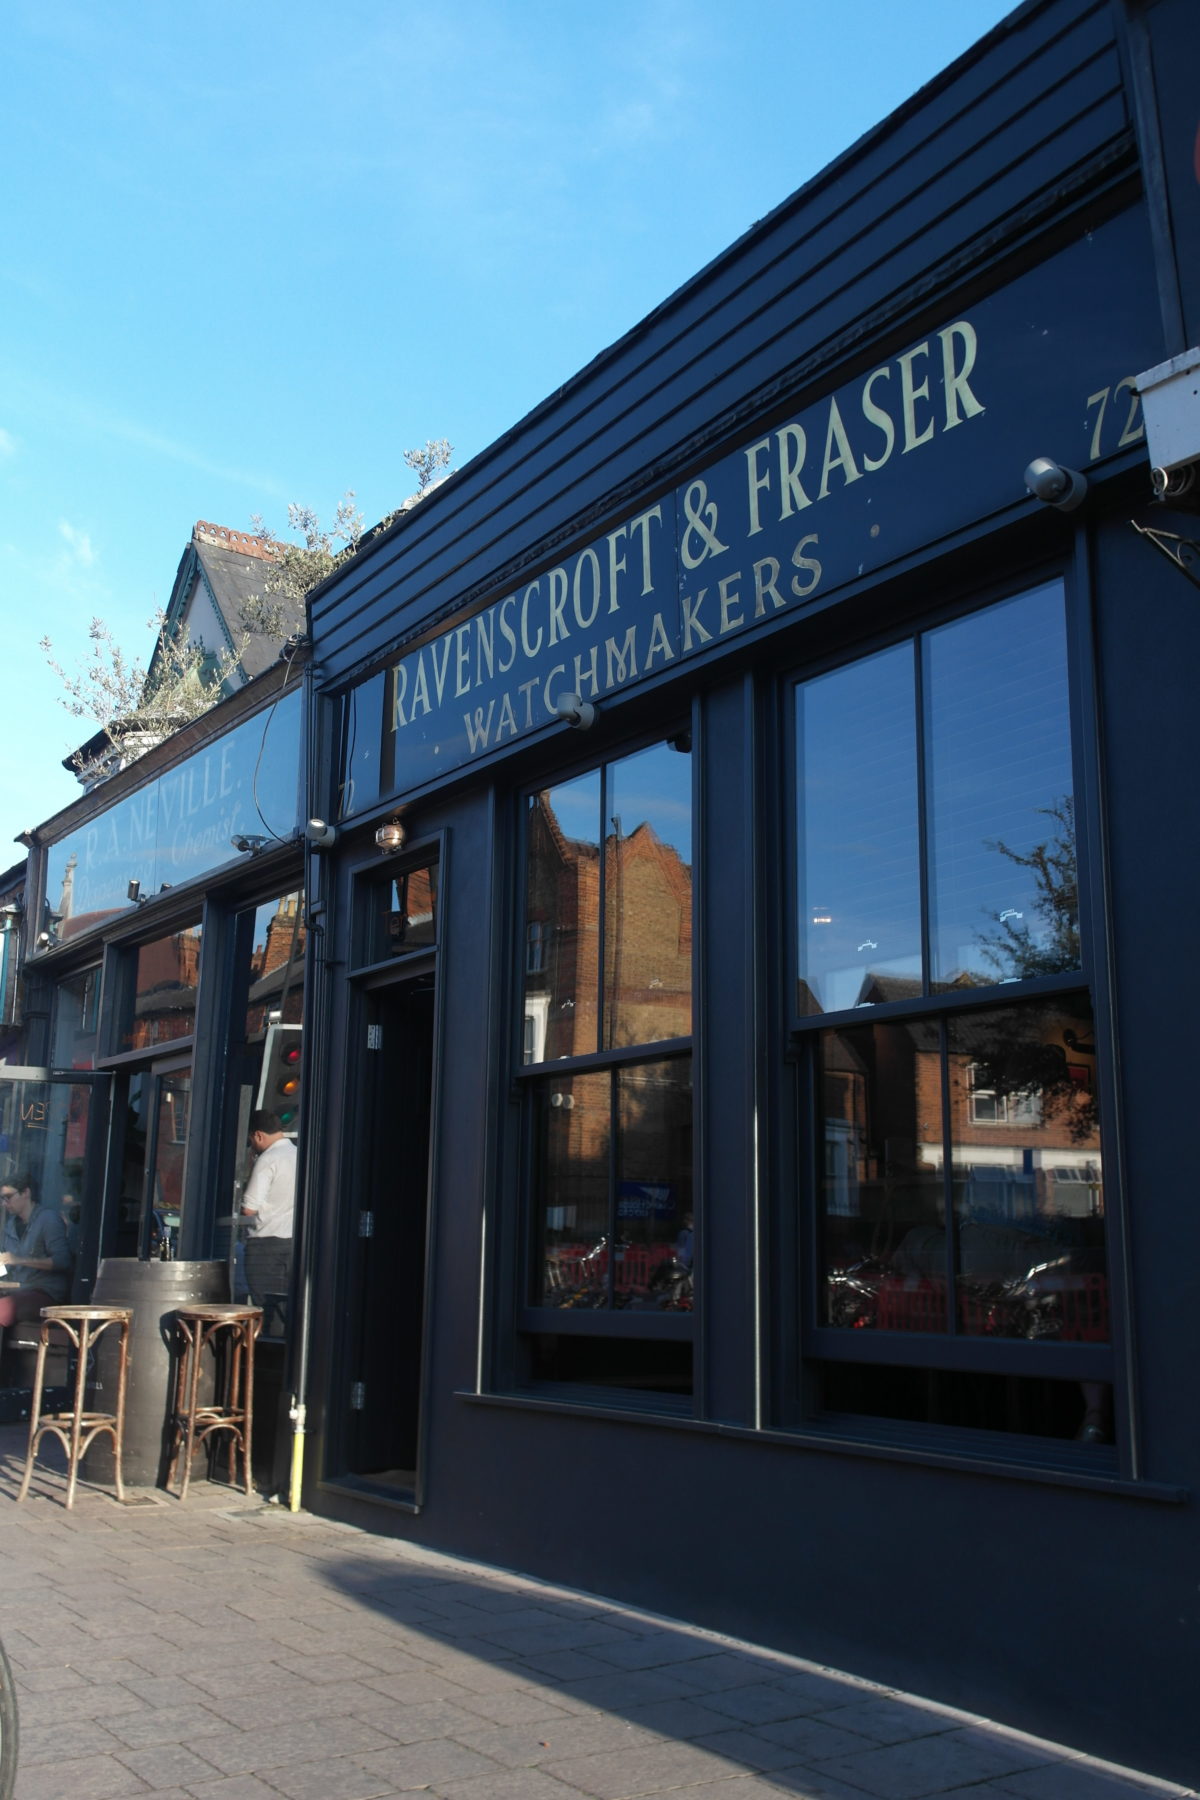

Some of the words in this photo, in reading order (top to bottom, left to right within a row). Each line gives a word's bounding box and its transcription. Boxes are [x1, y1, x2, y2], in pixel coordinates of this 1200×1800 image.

[391, 504, 663, 733] RAVENSCROFT
[681, 479, 730, 570] &
[744, 320, 986, 538] FRASER
[1086, 375, 1144, 461] 72
[463, 533, 823, 755] WATCHMAKERS
